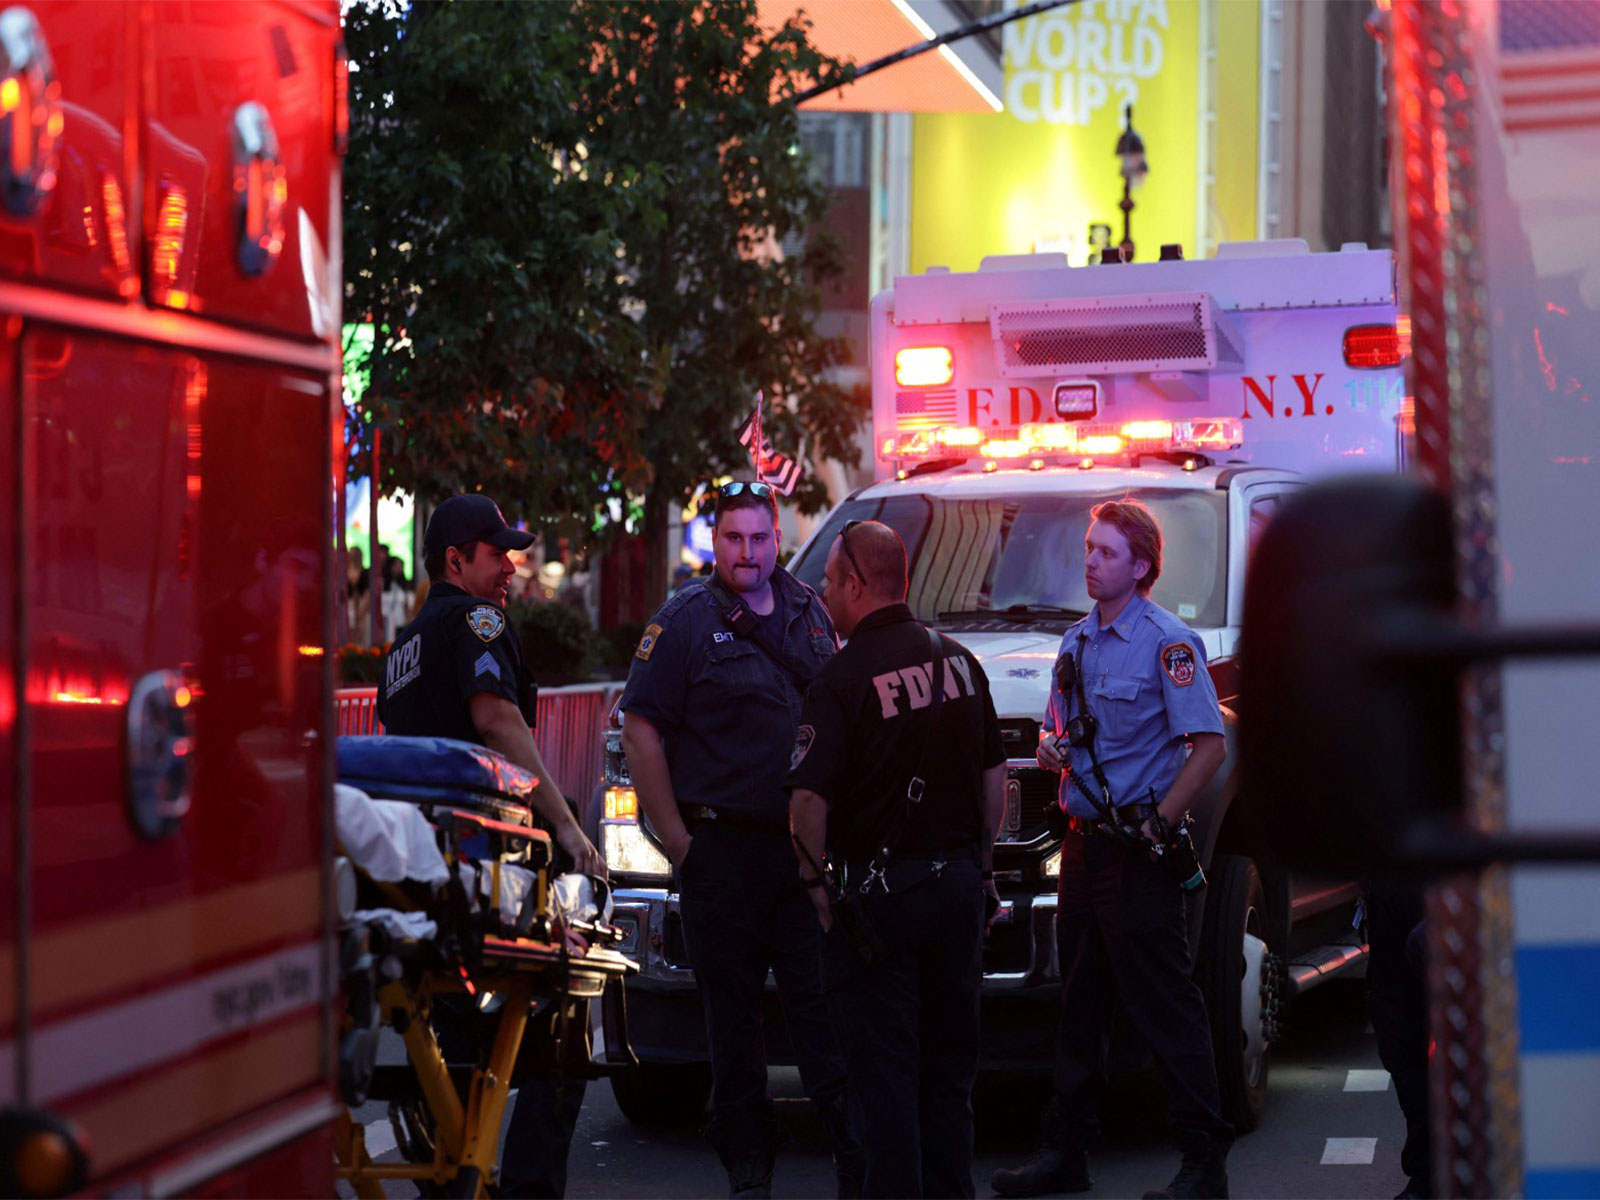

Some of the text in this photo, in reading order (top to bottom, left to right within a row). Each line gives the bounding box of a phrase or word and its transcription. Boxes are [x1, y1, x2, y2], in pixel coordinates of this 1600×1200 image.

[1007, 69, 1138, 130] CUP?
[967, 373, 1334, 426] F.D. N.Y.
[386, 633, 421, 687] NYPD
[713, 631, 734, 643] EMT
[872, 655, 976, 720] FDNY
